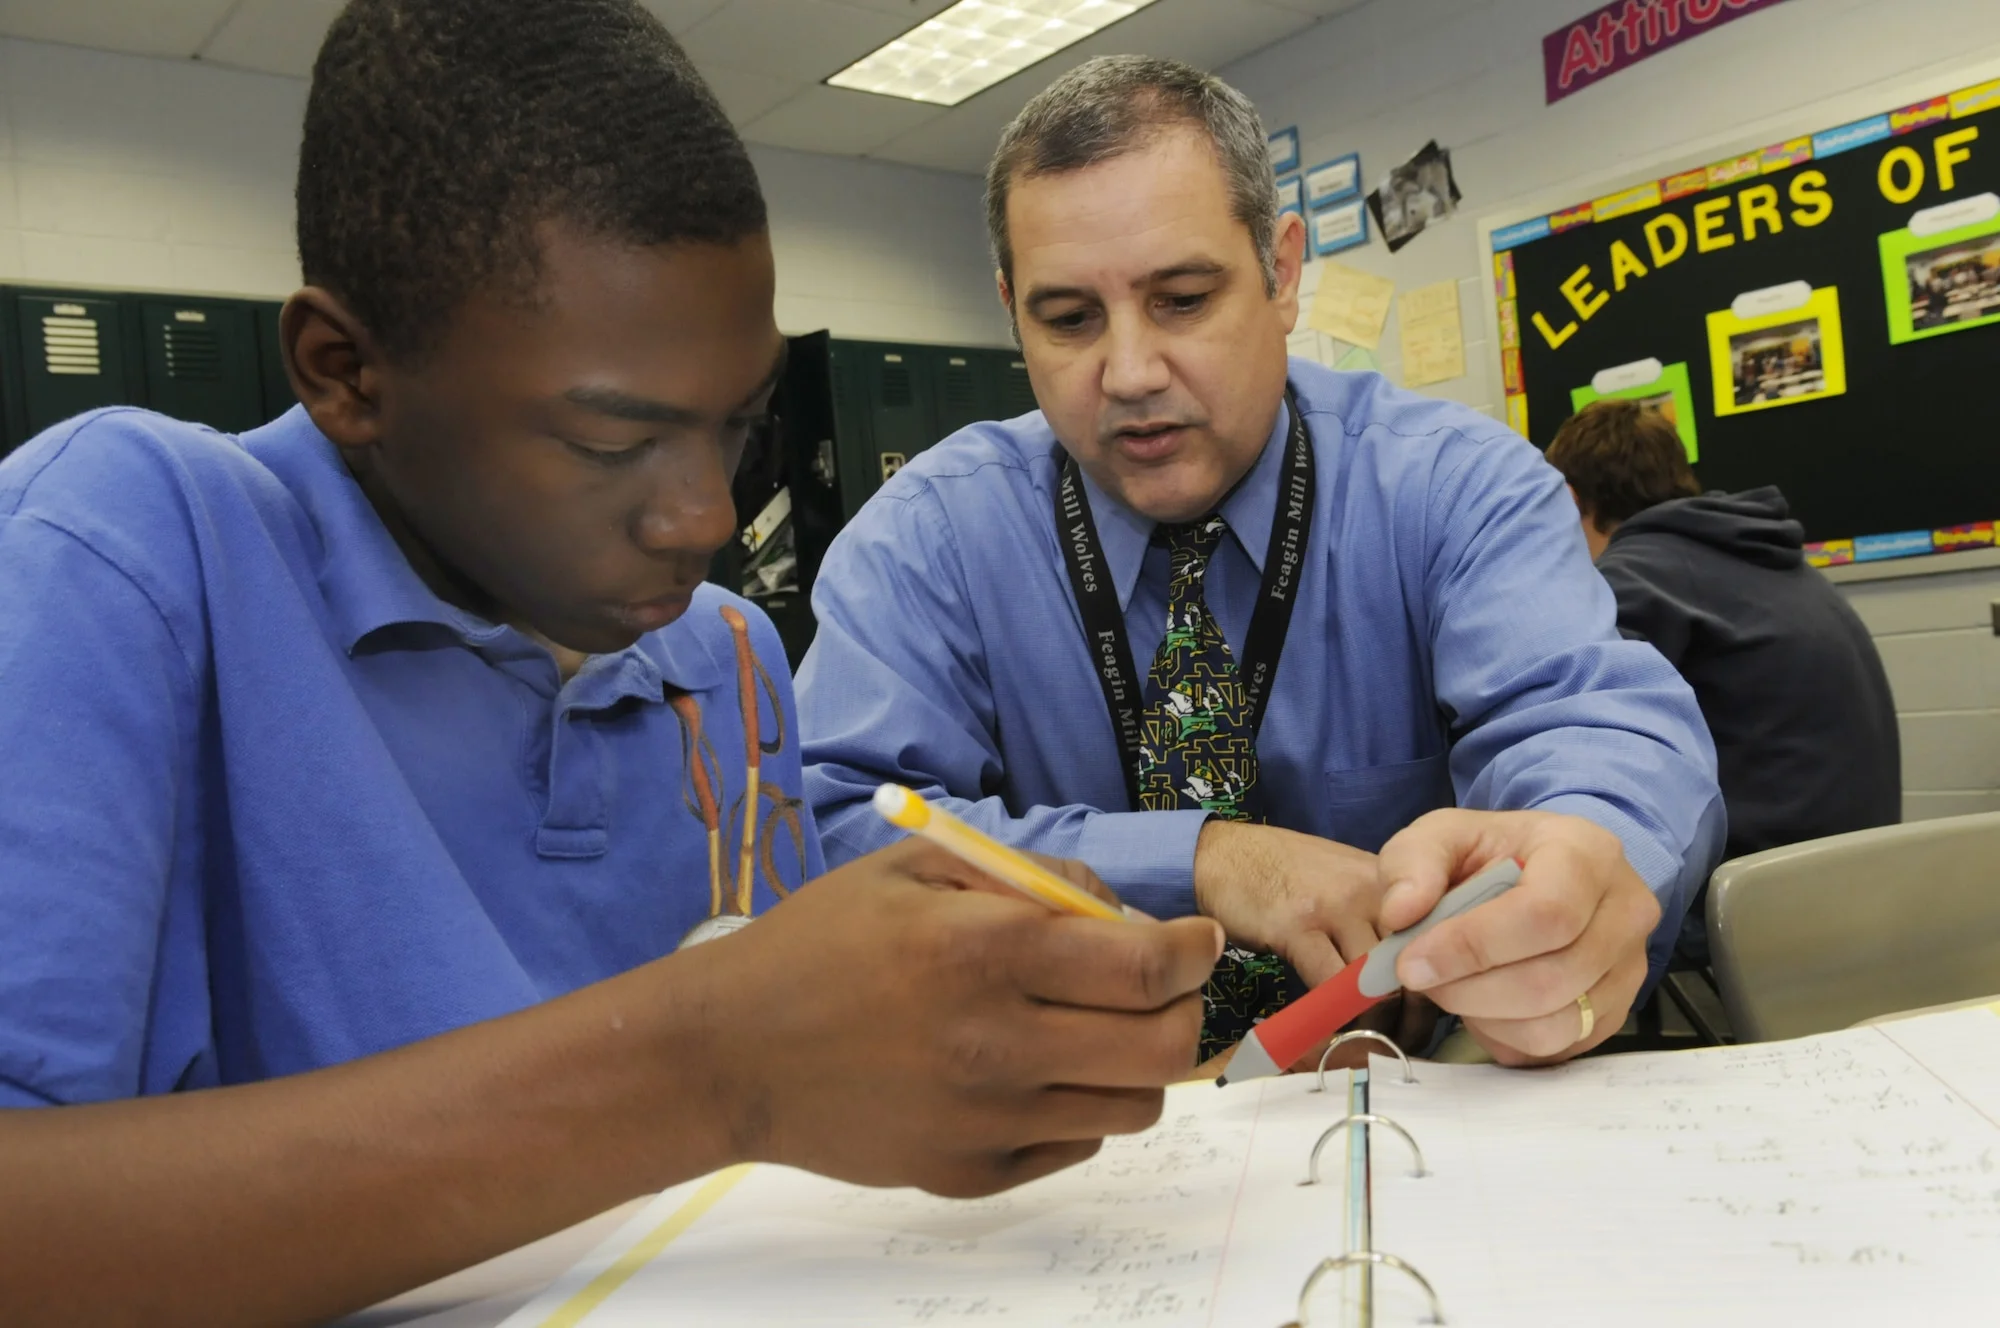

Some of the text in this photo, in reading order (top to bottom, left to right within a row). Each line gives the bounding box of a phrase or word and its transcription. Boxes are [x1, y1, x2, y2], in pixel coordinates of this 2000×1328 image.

[1531, 169, 1834, 350] LEADERS
[1877, 125, 1979, 205] OF
[1061, 475, 1098, 593] Mill Wolves
[1270, 528, 1299, 602] Feagin
[1287, 475, 1307, 521] Mill
[1098, 629, 1140, 752] Feagin Mill
